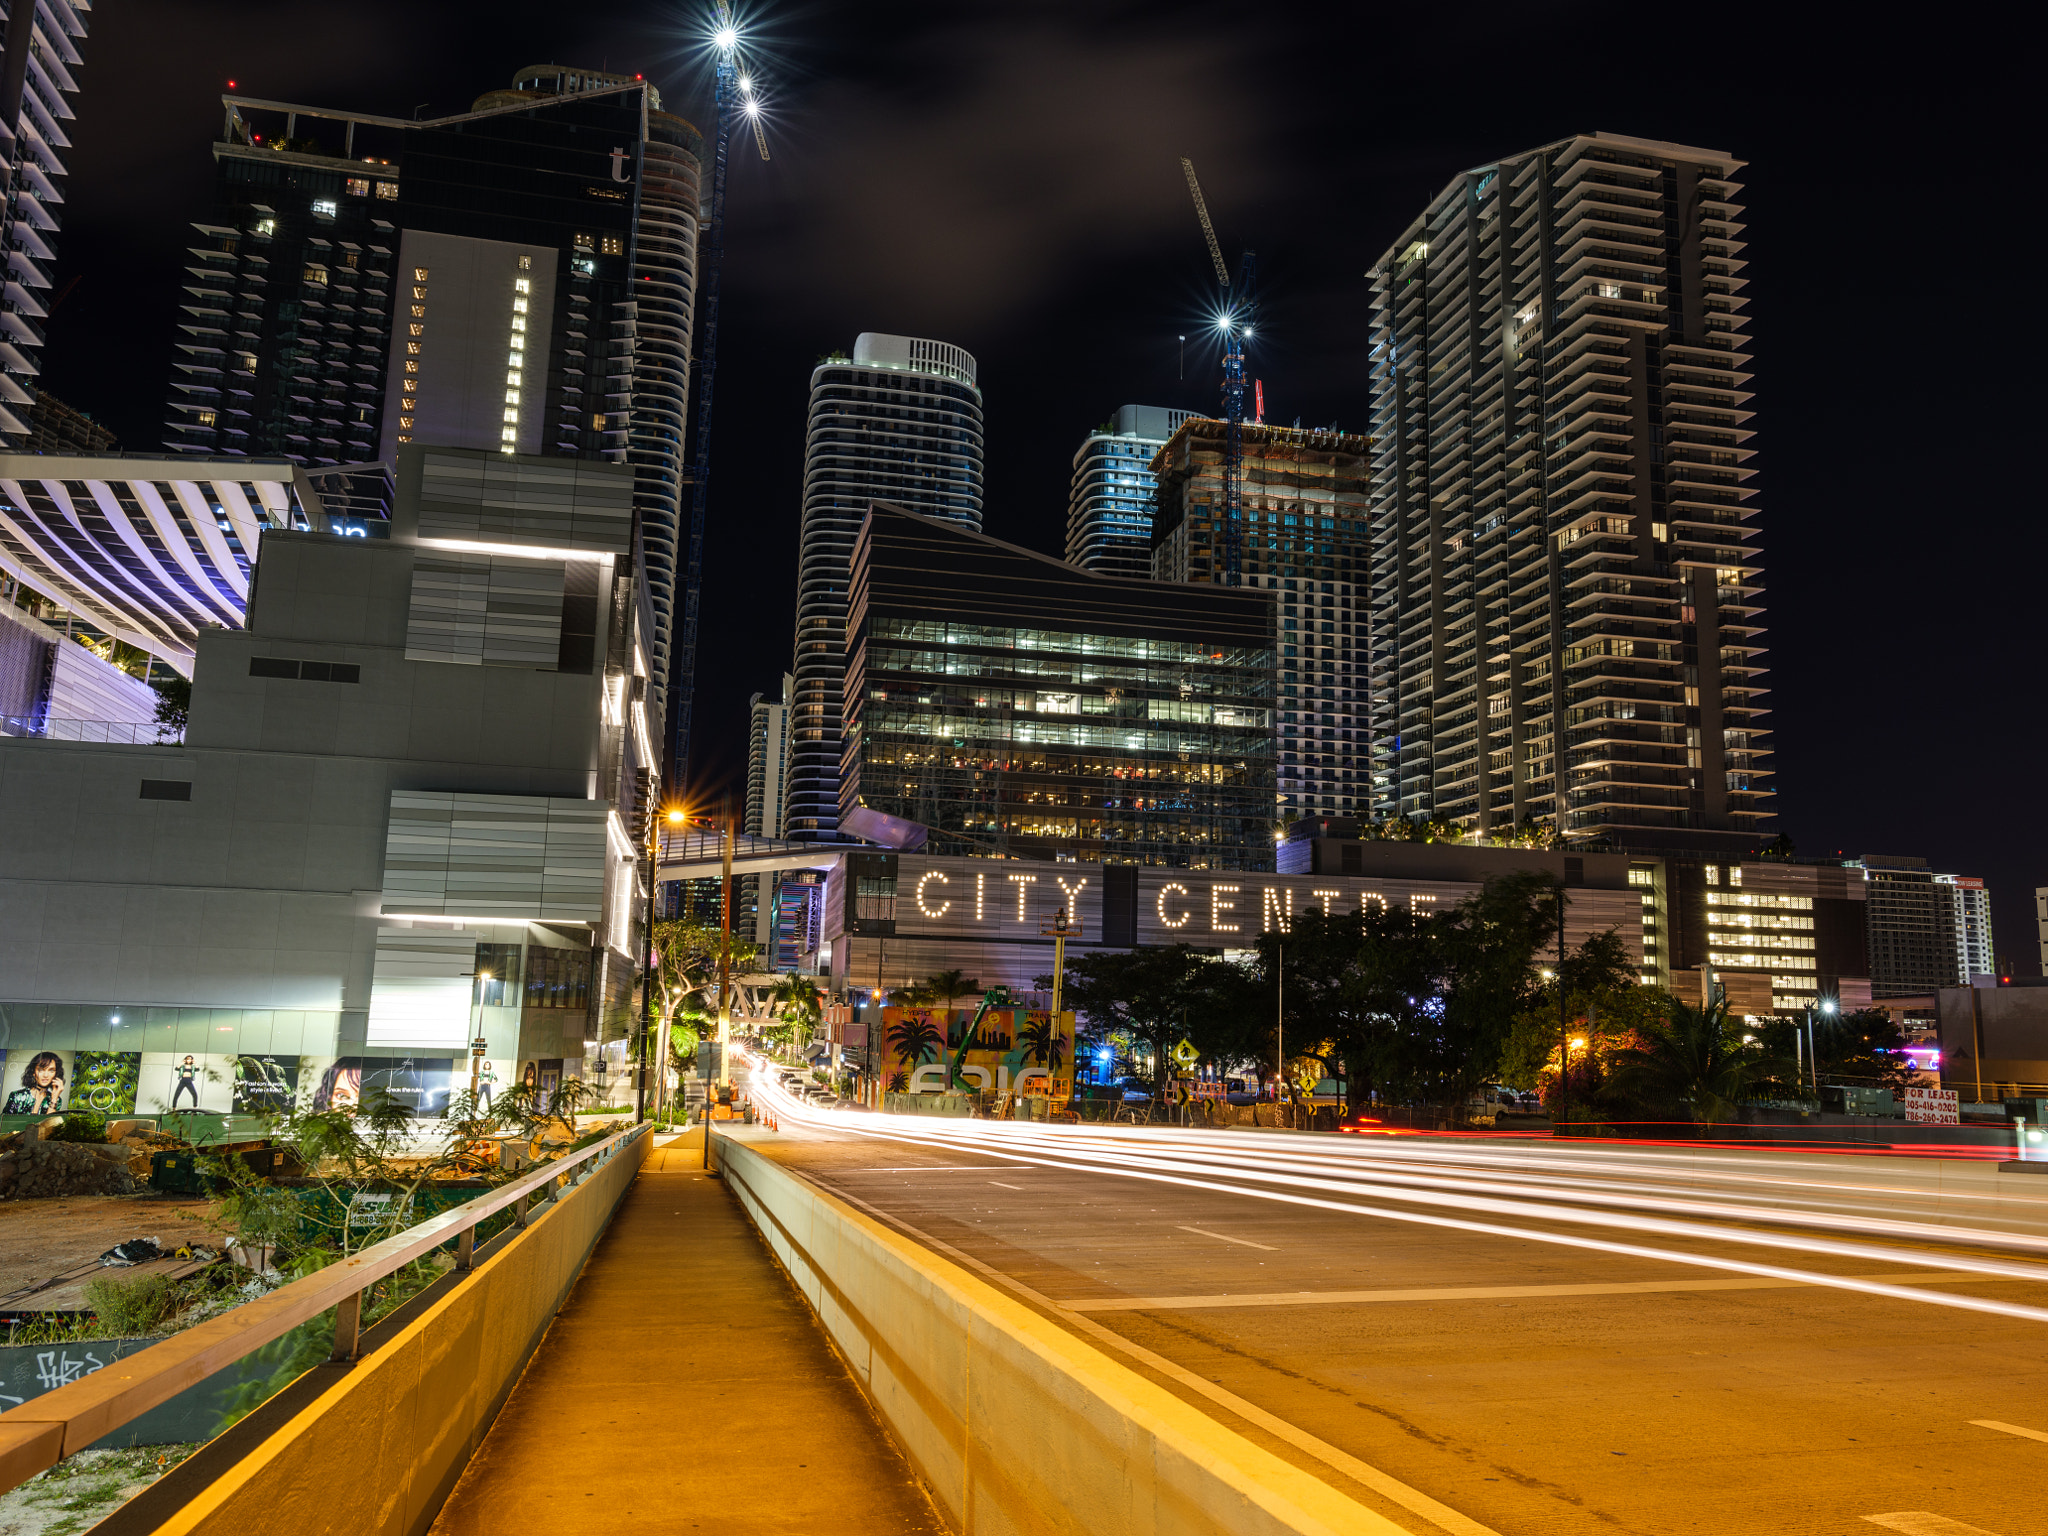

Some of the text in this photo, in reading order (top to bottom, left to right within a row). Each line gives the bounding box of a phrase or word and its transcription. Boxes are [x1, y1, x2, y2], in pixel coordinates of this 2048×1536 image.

[917, 871, 1086, 922] CITY
[1905, 1088, 1957, 1100] FOR LEASE
